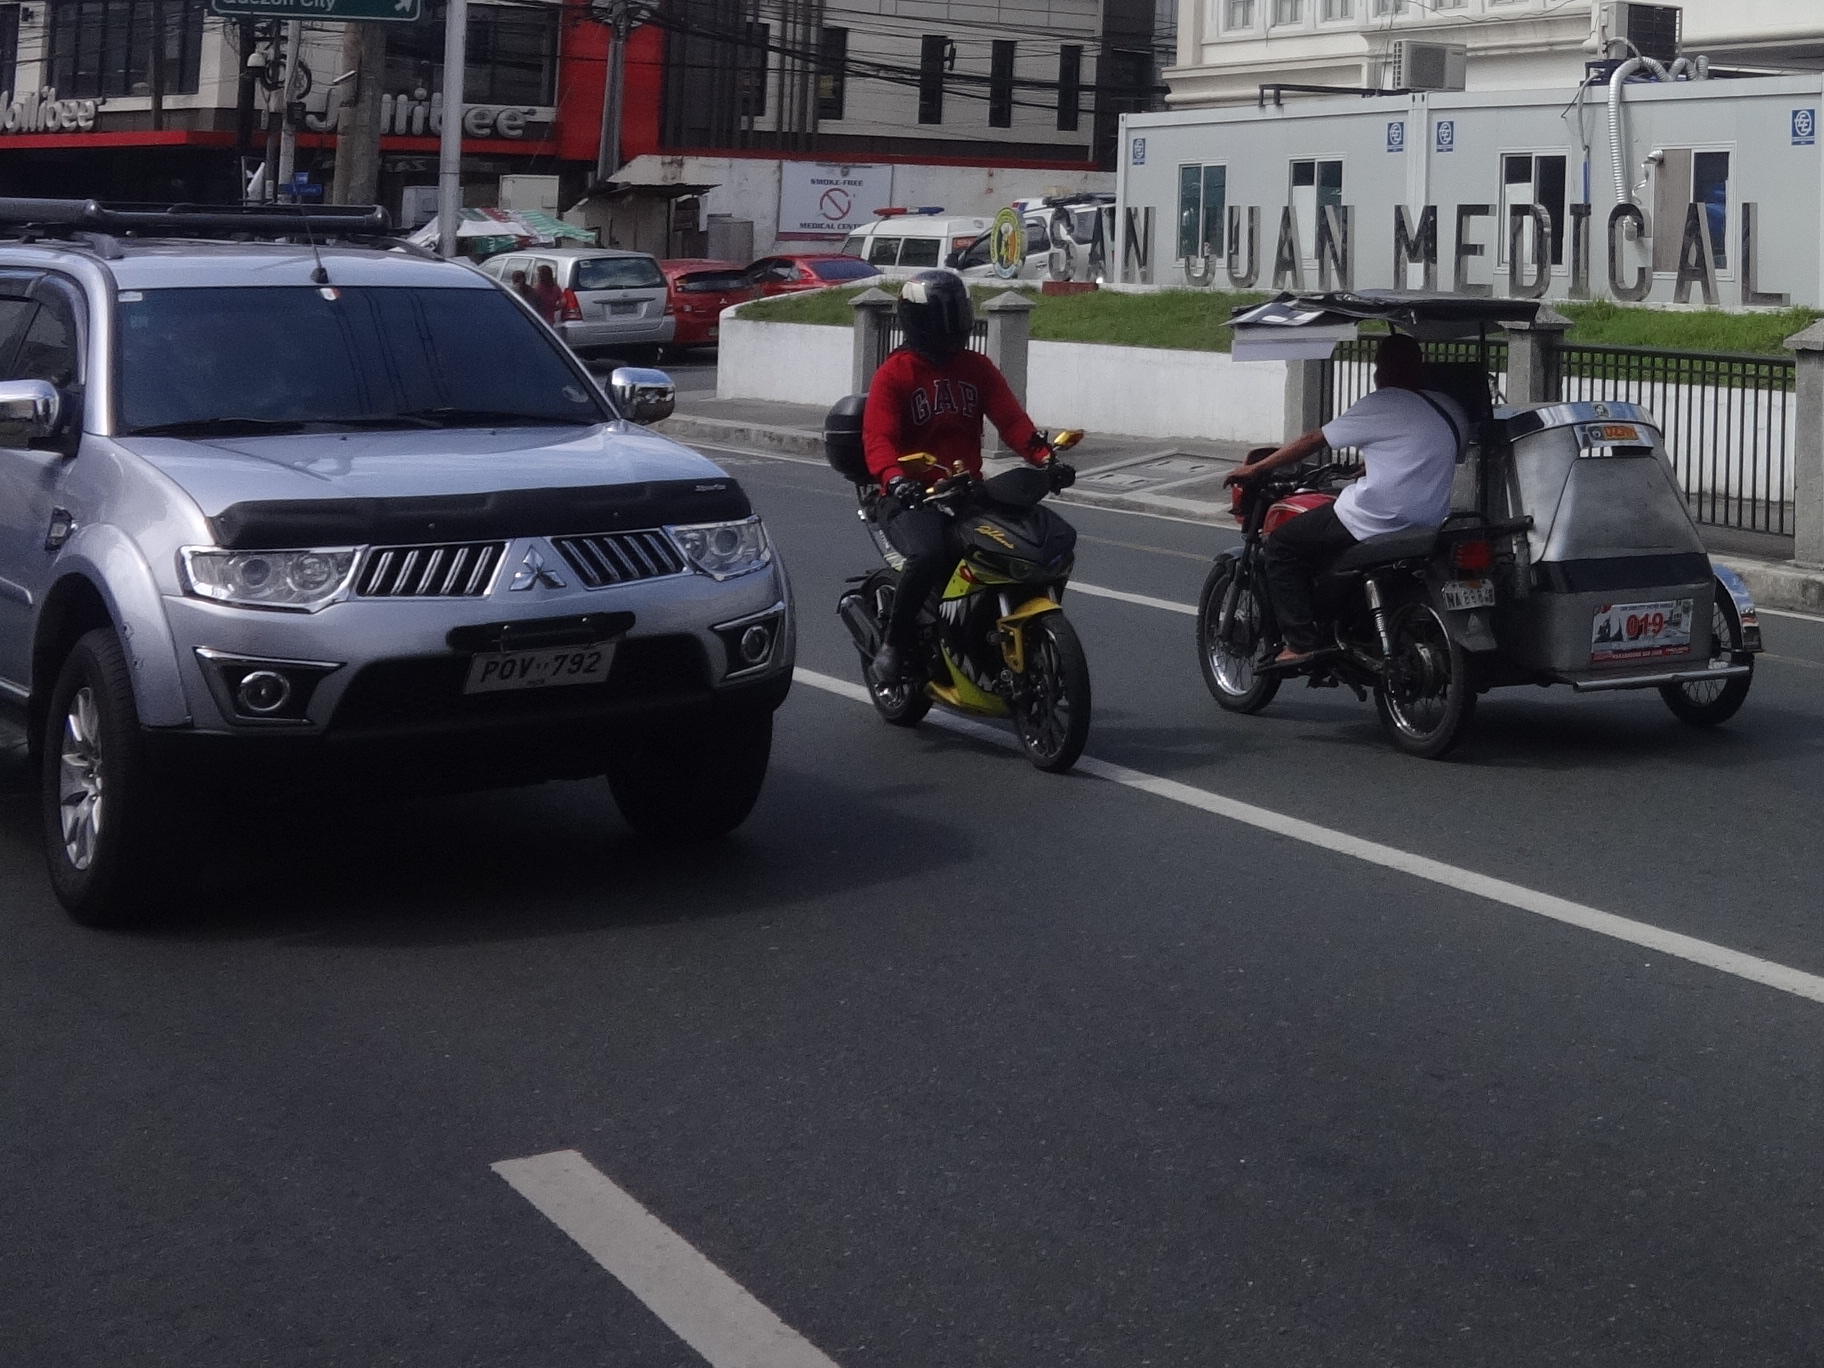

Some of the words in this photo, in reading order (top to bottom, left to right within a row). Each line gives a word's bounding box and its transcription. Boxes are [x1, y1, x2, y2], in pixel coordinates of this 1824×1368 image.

[305, 88, 528, 138] Jllibee
[799, 222, 835, 230] MEDICAL
[1049, 206, 1156, 284] SAN
[1184, 205, 1354, 291] JUAN
[1395, 202, 1790, 307] MEDICAL
[911, 379, 979, 426] GAP
[549, 650, 603, 677] 792
